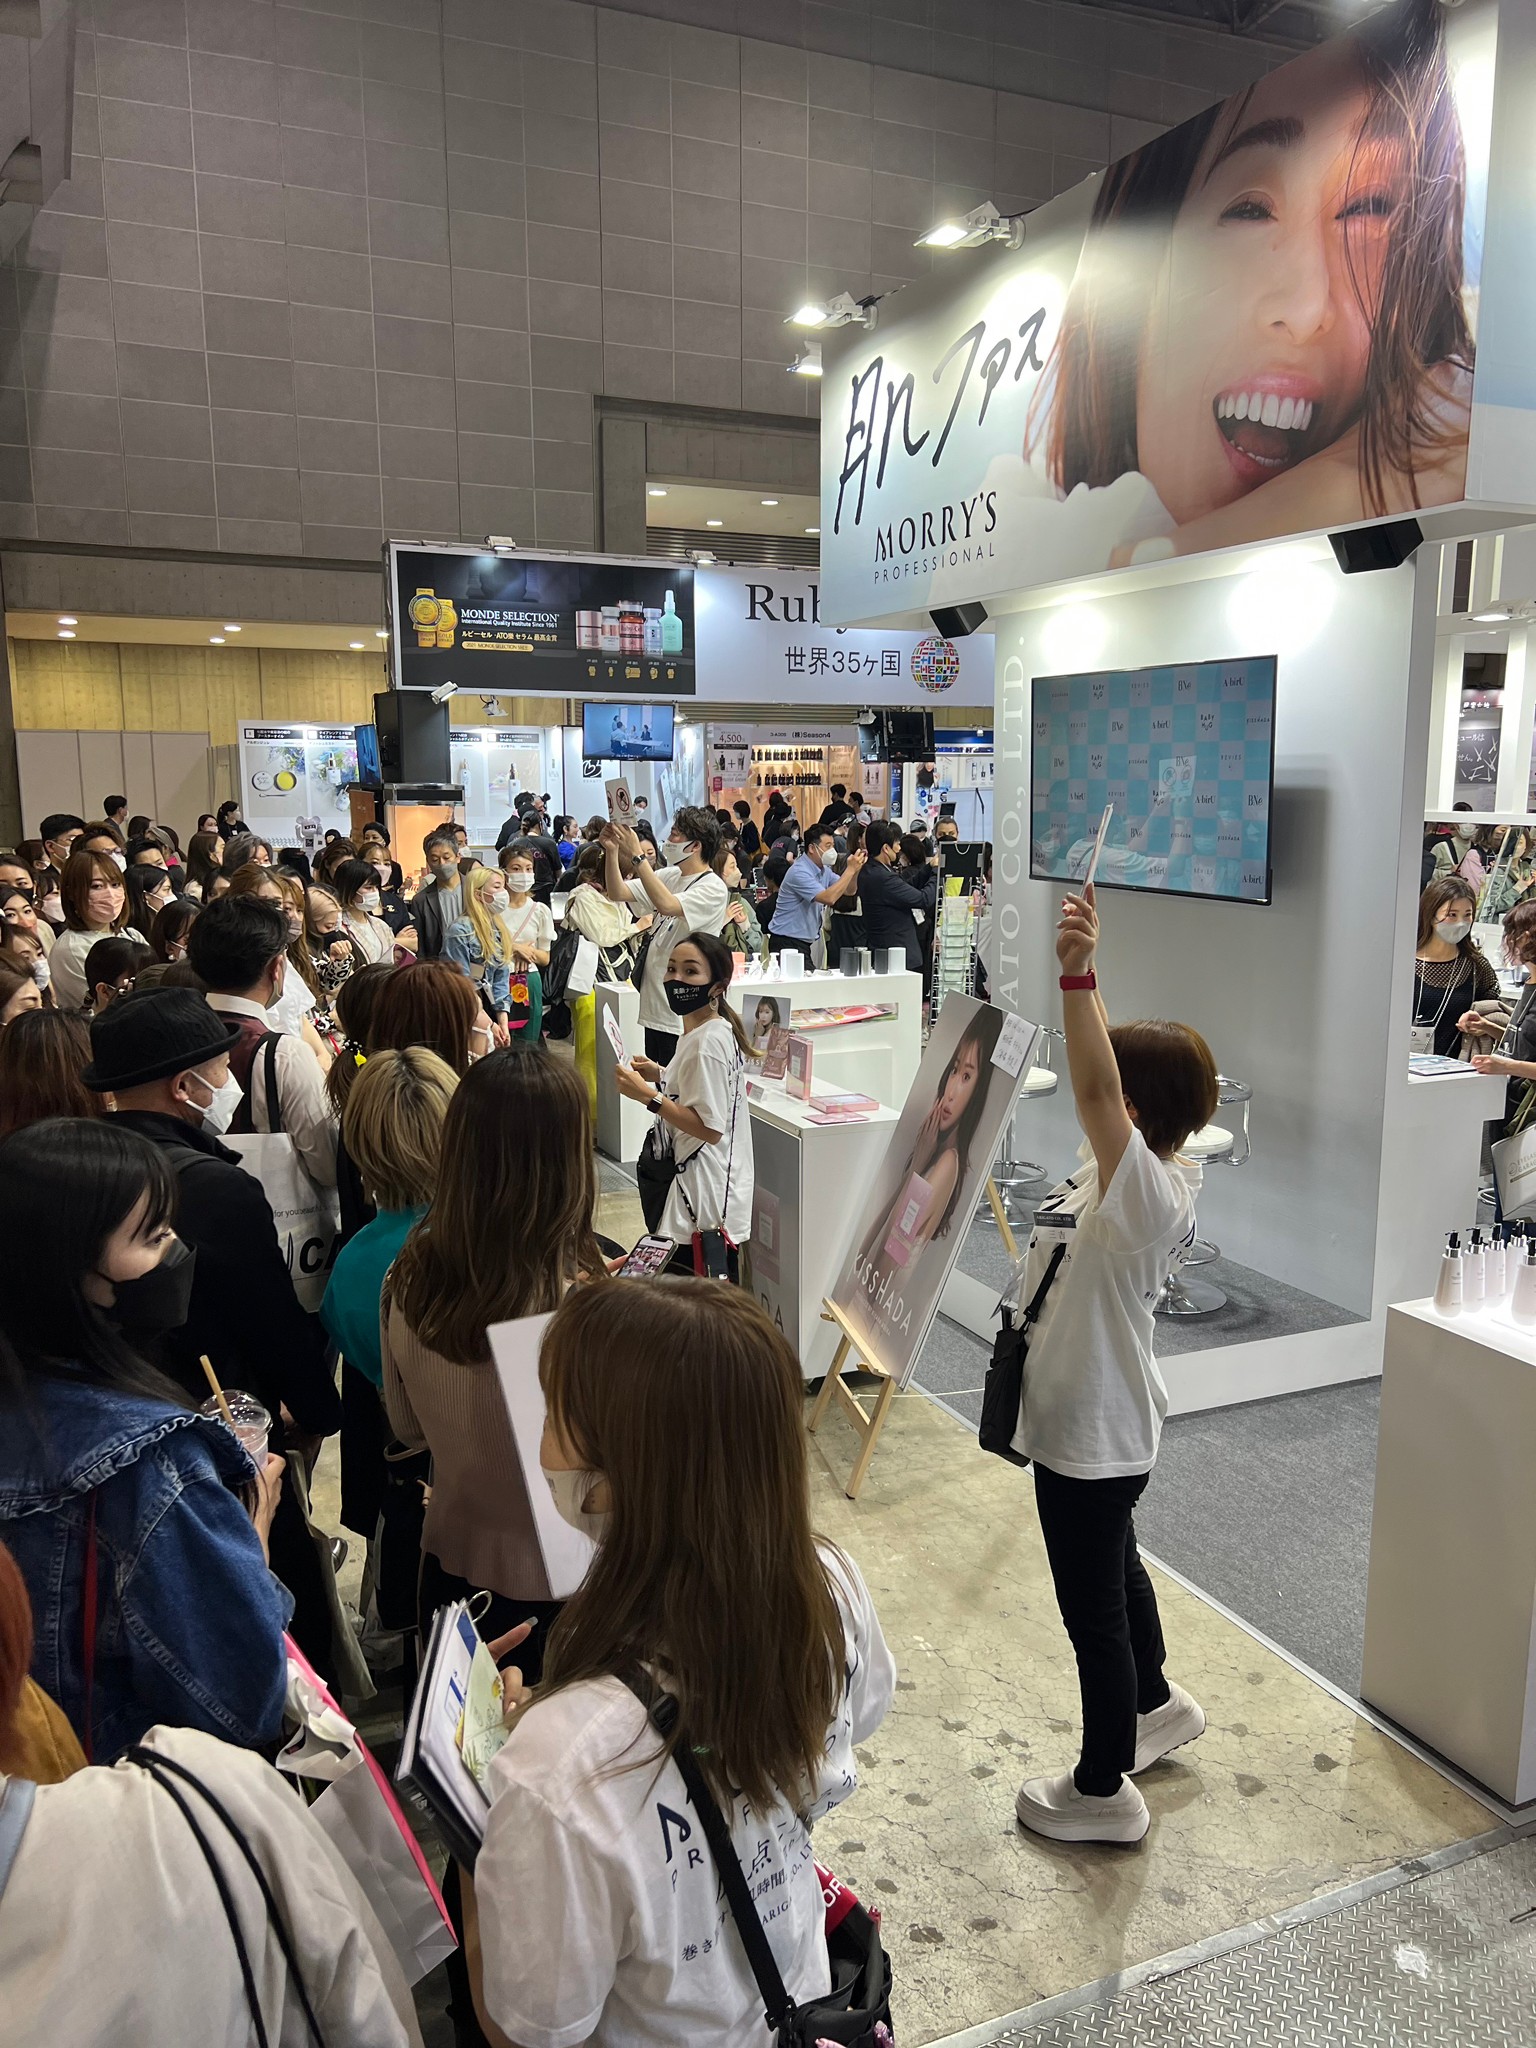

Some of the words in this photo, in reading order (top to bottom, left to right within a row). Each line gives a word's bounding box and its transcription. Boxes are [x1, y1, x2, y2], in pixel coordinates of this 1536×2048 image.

[875, 491, 997, 562] MORRY'S
[874, 543, 995, 584] PROFESSIONAL
[461, 608, 500, 619] MONDE
[503, 610, 558, 623] SELECTION
[493, 620, 511, 628] Quality
[719, 734, 742, 743] 4,500
[273, 1209, 284, 1218] for
[283, 1208, 299, 1219] you
[849, 1250, 913, 1336] KISSHADA
